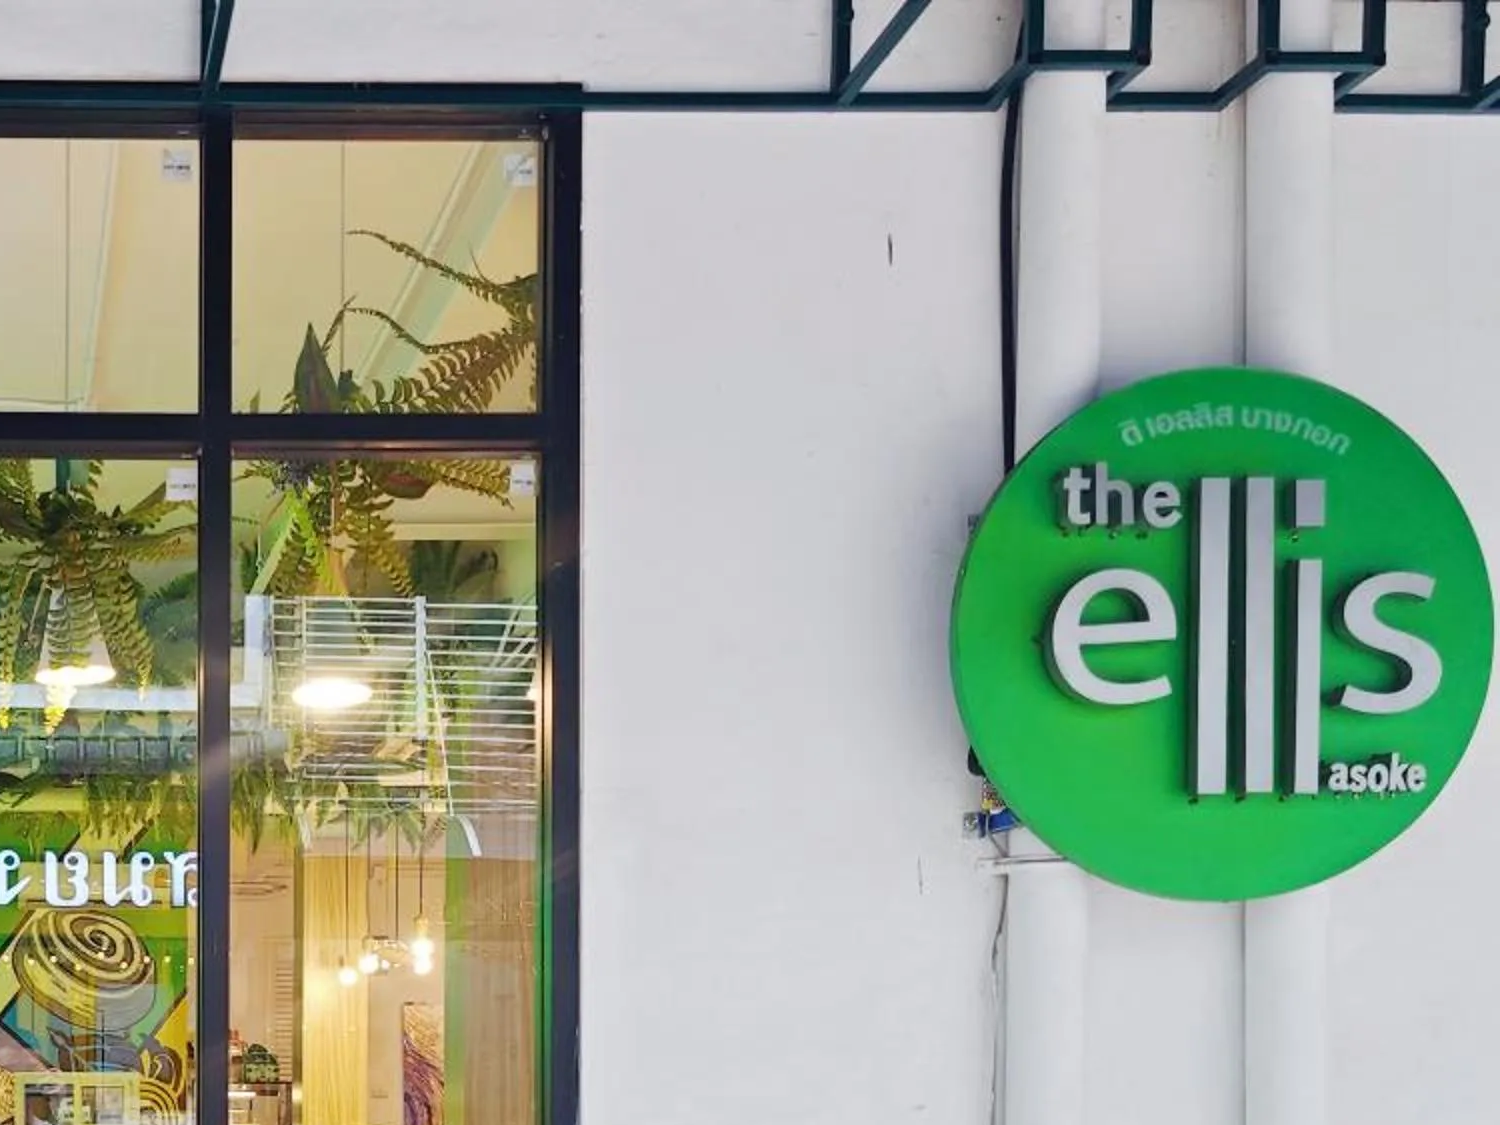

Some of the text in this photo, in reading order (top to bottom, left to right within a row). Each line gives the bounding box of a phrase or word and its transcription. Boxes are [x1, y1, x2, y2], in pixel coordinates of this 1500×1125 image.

[1241, 405, 1351, 455] บางกอก
[1062, 461, 1183, 528] the
[1052, 477, 1443, 795] ellis
[1328, 754, 1427, 793] asoke
